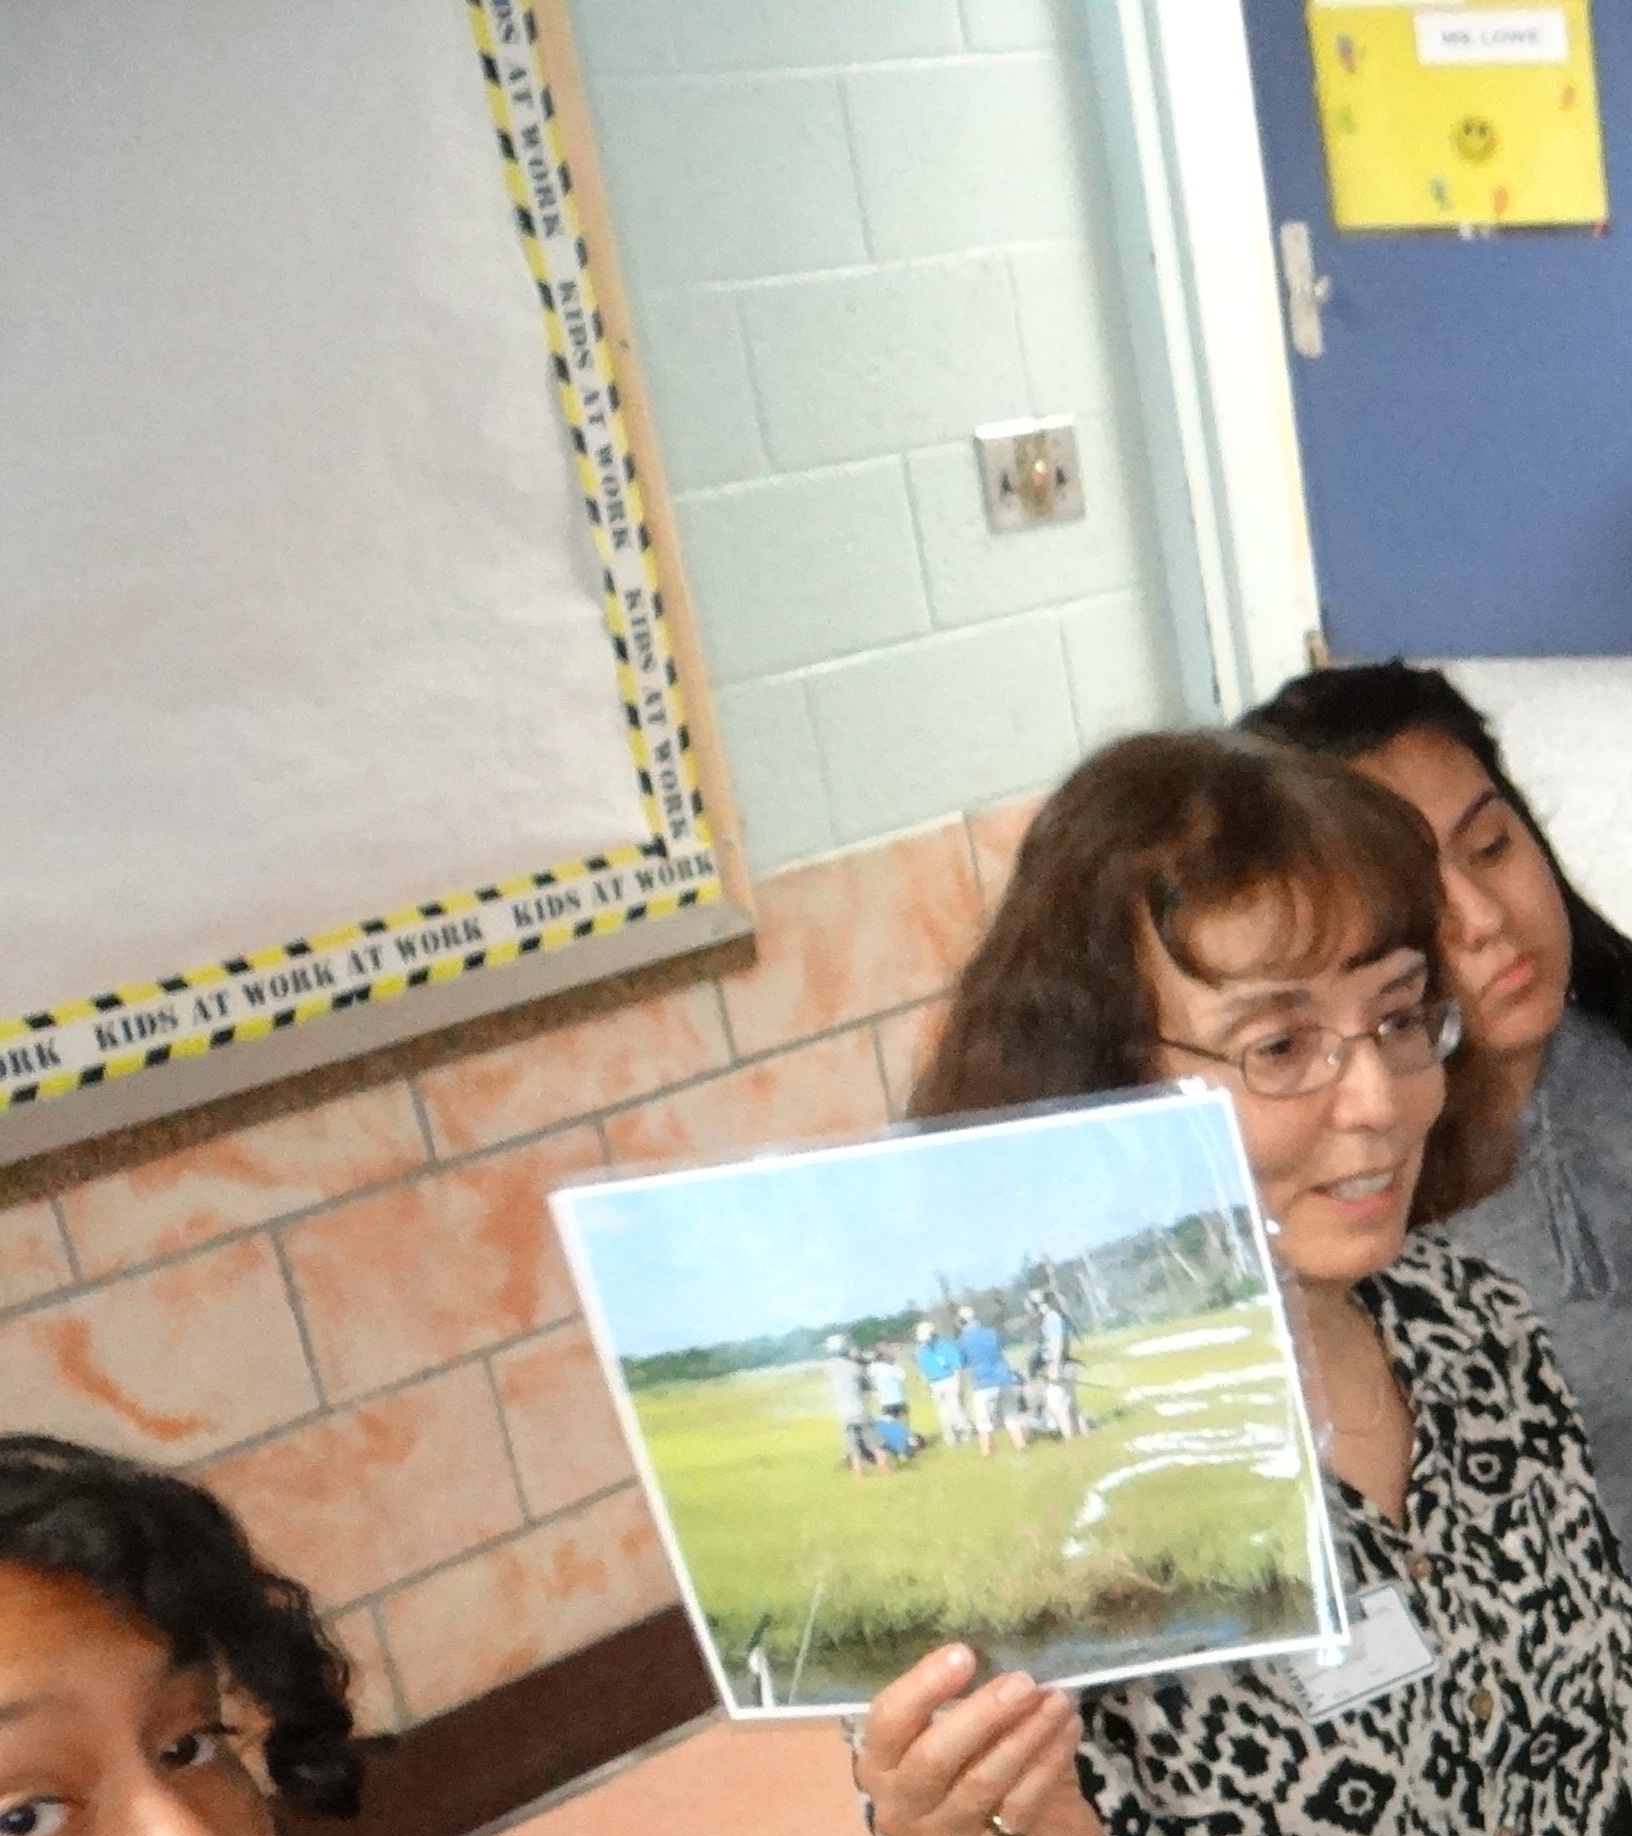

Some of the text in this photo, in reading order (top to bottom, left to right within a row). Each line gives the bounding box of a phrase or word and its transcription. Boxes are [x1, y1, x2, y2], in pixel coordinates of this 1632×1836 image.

[521, 122, 565, 239] WORK
[558, 281, 629, 551] KIDS AT WORK
[625, 587, 686, 840] KIDS AT WORK
[95, 1003, 179, 1052] KIDS
[192, 988, 229, 1026] AT
[242, 958, 335, 1008] WORK
[349, 944, 384, 975] AT
[394, 916, 483, 964] WORK
[511, 889, 582, 929] KIDS
[591, 875, 625, 905] AT
[634, 852, 714, 893] WORK
